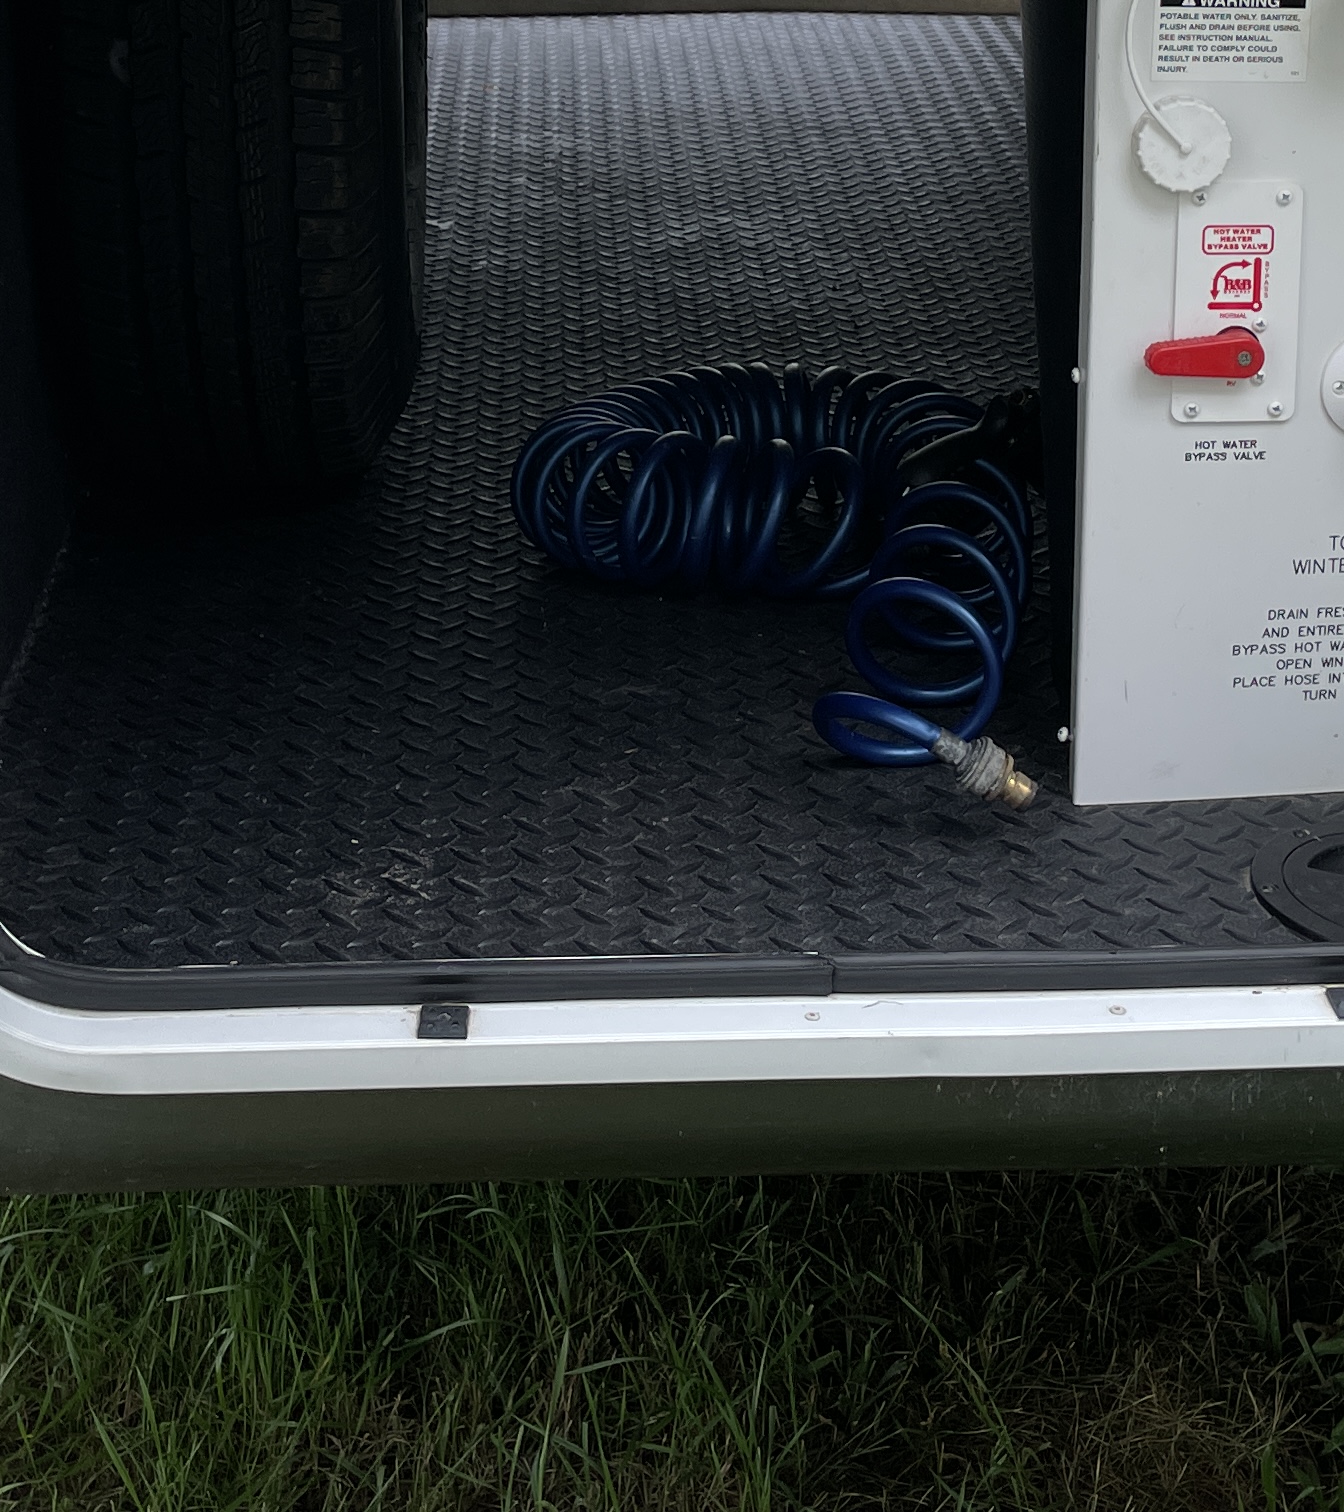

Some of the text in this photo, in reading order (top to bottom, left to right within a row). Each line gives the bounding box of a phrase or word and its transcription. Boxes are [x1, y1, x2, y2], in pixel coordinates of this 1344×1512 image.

[1160, 12, 1199, 21] POTABLE
[1202, 13, 1231, 21] WATER
[1159, 23, 1187, 31] FLUSH
[1237, 24, 1271, 32] BEFORE
[1158, 34, 1175, 42] SEE
[1177, 34, 1234, 42] INSTRUCTION
[1158, 44, 1278, 53] FAILURE TO COMPLY COULD
[1157, 55, 1190, 63] RESULT
[1192, 55, 1200, 63] IN
[1202, 55, 1230, 63] DEATH
[1247, 56, 1283, 64] SERIOUS
[1194, 440, 1257, 450] HOT WATER
[1184, 451, 1266, 462] BYPASS VALVE
[1267, 608, 1309, 621] DRAIN
[1262, 626, 1290, 639] AND
[1298, 624, 1344, 637] ENTIRE
[1232, 643, 1286, 656] BYPASS
[1294, 641, 1323, 654] HOT
[1276, 658, 1312, 671] OPEN
[1232, 675, 1277, 689] PLACE
[1284, 673, 1320, 686] HOSE
[1302, 689, 1337, 701] TURN
